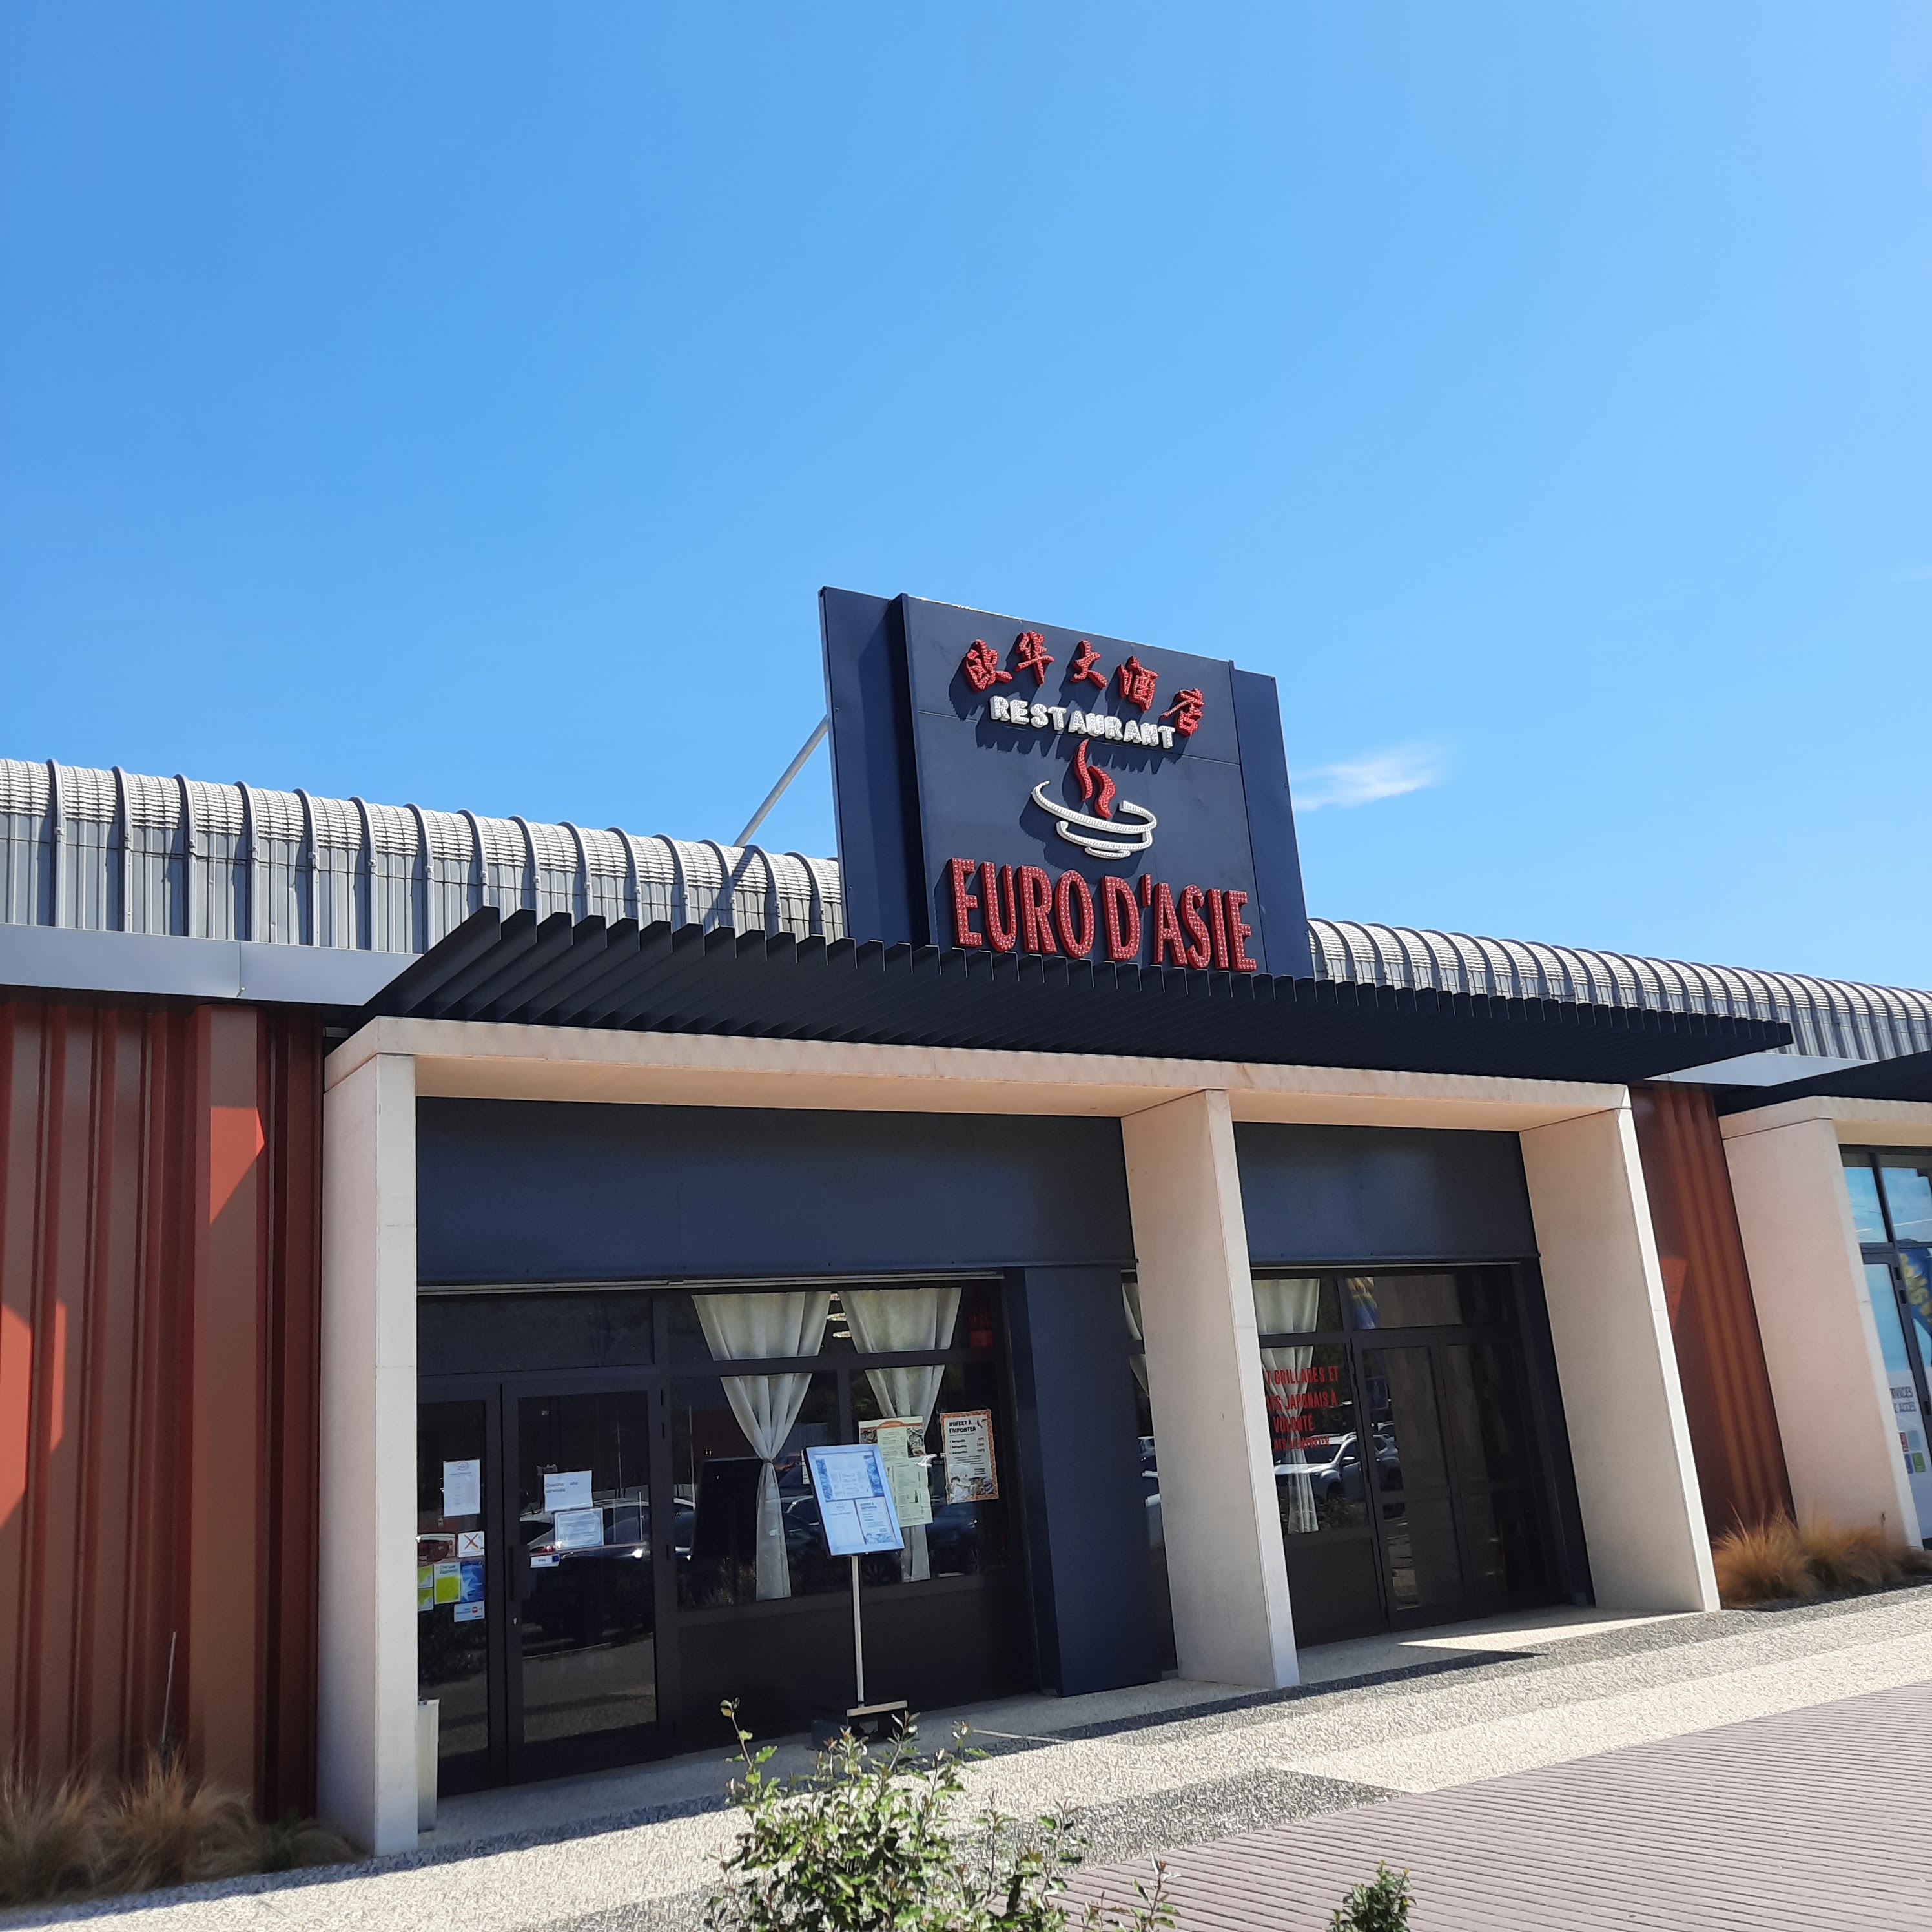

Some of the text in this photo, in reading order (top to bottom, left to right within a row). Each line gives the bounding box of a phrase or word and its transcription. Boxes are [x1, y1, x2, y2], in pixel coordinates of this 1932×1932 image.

[990, 695, 1175, 748] RESTAURANT
[947, 857, 1257, 972] EURO D'ASIE
[1274, 1367, 1326, 1385] GRILLADES
[1328, 1366, 1339, 1382] ET
[1266, 1395, 1282, 1412] ATS
[1285, 1392, 1329, 1410] JAPONAIS
[1273, 1413, 1315, 1433] VOLONTÉ
[1273, 1438, 1286, 1452] ATS
